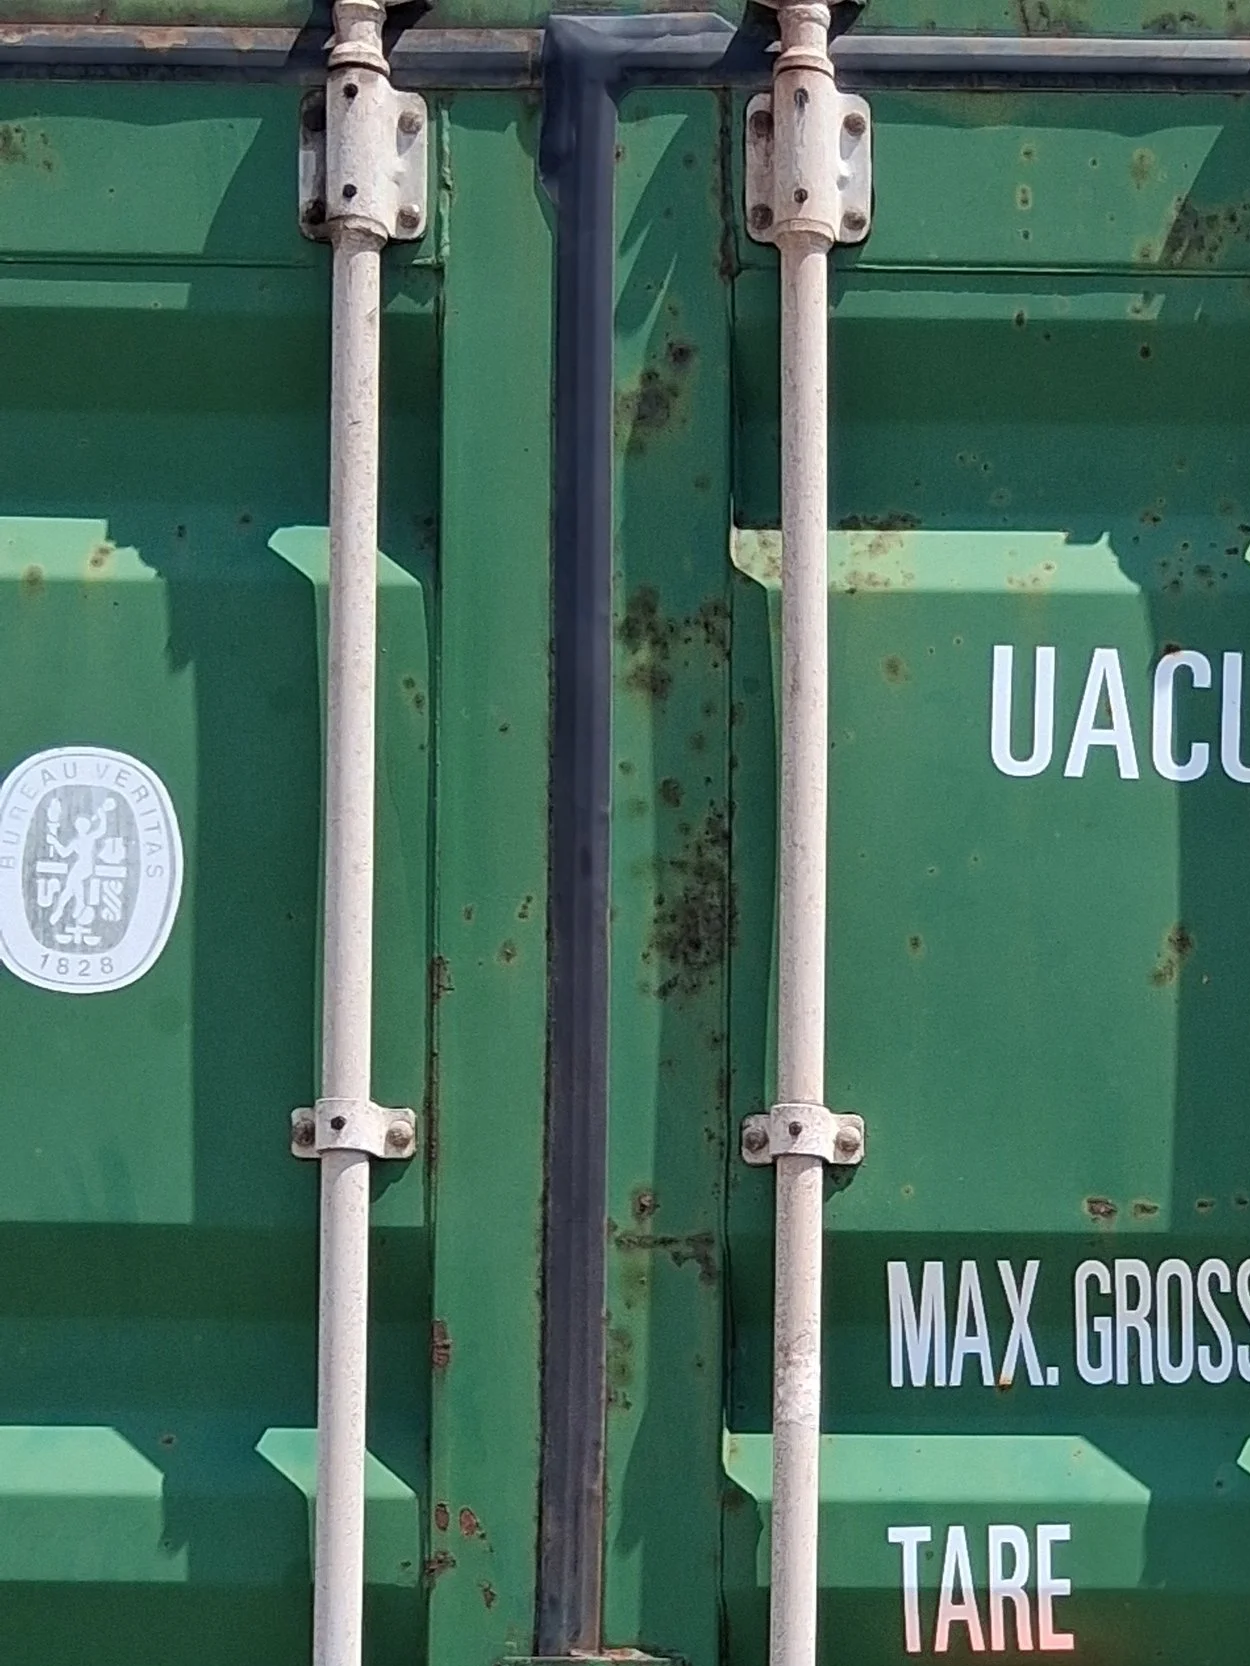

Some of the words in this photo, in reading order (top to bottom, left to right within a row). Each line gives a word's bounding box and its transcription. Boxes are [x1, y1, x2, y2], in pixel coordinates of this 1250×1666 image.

[95, 763, 164, 879] VERITAS
[39, 951, 115, 977] 1828
[887, 1260, 1059, 1388] MAX.
[887, 1523, 1075, 1653] TARE
